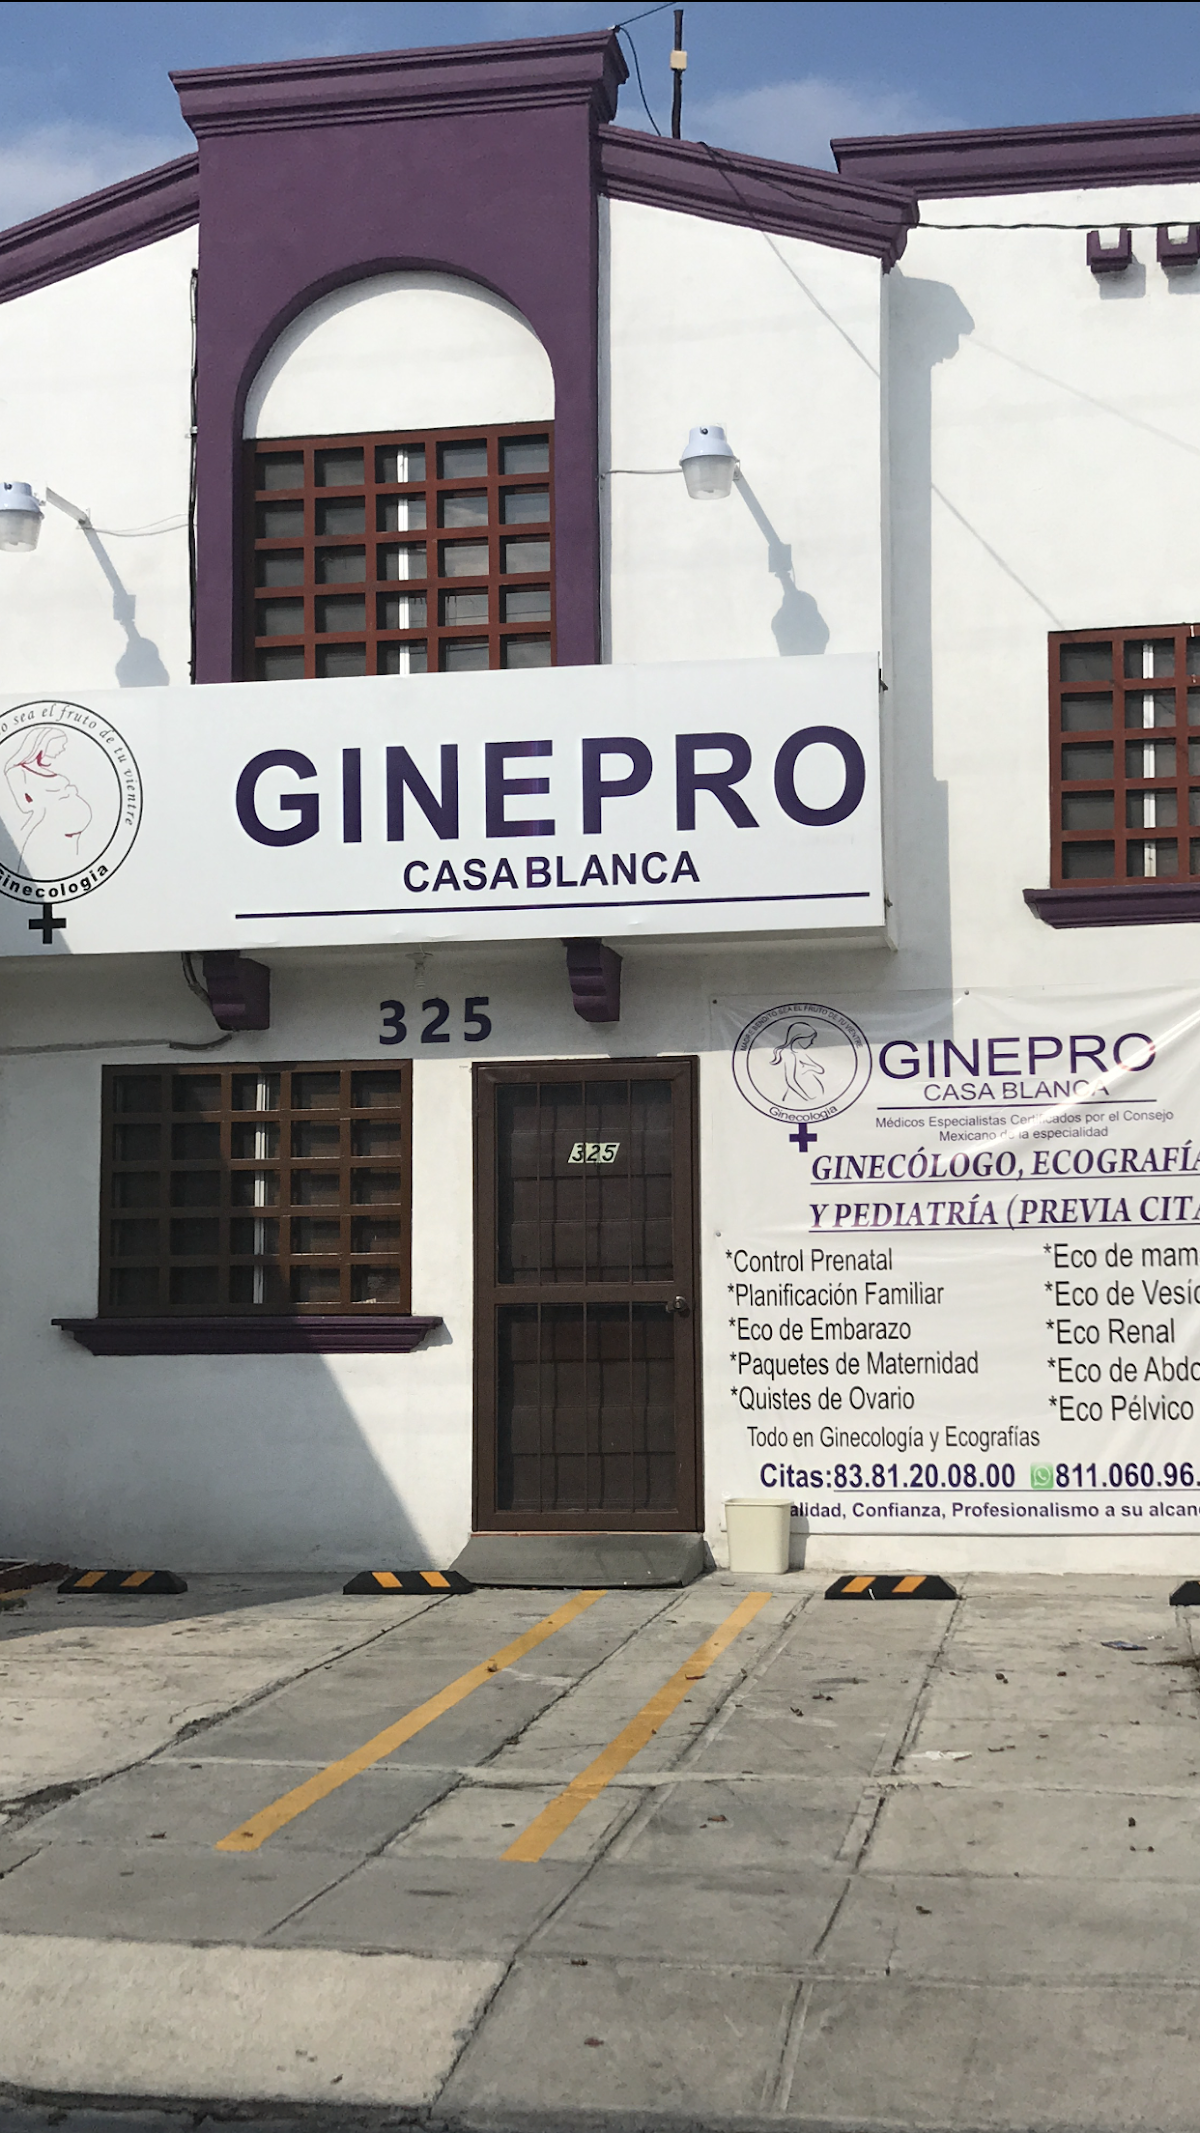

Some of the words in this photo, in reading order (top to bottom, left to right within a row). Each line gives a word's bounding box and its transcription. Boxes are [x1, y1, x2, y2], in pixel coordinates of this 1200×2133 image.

[13, 710, 35, 725] sea
[41, 703, 57, 718] el
[55, 704, 98, 730] fruto
[99, 728, 115, 745] de
[113, 747, 128, 764] tu
[123, 768, 138, 827] vientre
[235, 725, 866, 848] GINEPRO
[379, 996, 492, 1045] 325
[878, 1032, 1157, 1080] GINEPRO
[923, 1082, 996, 1101] CASA
[1002, 1079, 1110, 1099] BLANCA
[875, 1116, 925, 1128] Médicos
[928, 1114, 1007, 1129] Especialistas
[1085, 1113, 1105, 1126] por
[1108, 1110, 1120, 1122] el
[1123, 1109, 1174, 1124] Consejo
[939, 1129, 997, 1142] Mexicano
[1032, 1126, 1109, 1141] especialidad
[571, 1143, 618, 1163] 325
[811, 1146, 1025, 1181] GINECÓLOGO,
[809, 1203, 830, 1229] Y
[831, 1193, 999, 1229] PEDIATRÍA
[1007, 1193, 1133, 1231] (PREVIA
[810, 1247, 893, 1272] Prenatal
[1104, 1242, 1133, 1267] de
[1141, 1246, 1200, 1267] mam
[865, 1281, 945, 1306] Familiar
[1105, 1280, 1135, 1306] de
[779, 1317, 804, 1341] de
[810, 1316, 912, 1341] Embarazo
[1108, 1317, 1176, 1345] Renal
[835, 1351, 860, 1375] de
[866, 1350, 979, 1375] Maternidad
[1109, 1356, 1138, 1383] de
[817, 1386, 842, 1411] de
[849, 1385, 915, 1410] Ovario
[1110, 1394, 1194, 1421] Pélvico
[746, 1426, 788, 1448] Todo
[792, 1431, 814, 1448] en
[819, 1425, 924, 1452] Ginecología
[929, 1430, 940, 1452] y
[944, 1424, 1041, 1452] Ecografías
[789, 1502, 847, 1520] alidad,
[852, 1501, 946, 1520] Confianza,
[951, 1501, 1100, 1518] Profesionalismo
[1105, 1505, 1115, 1518] a
[1121, 1504, 1143, 1518] su
[1148, 1501, 1200, 1518] alcan
